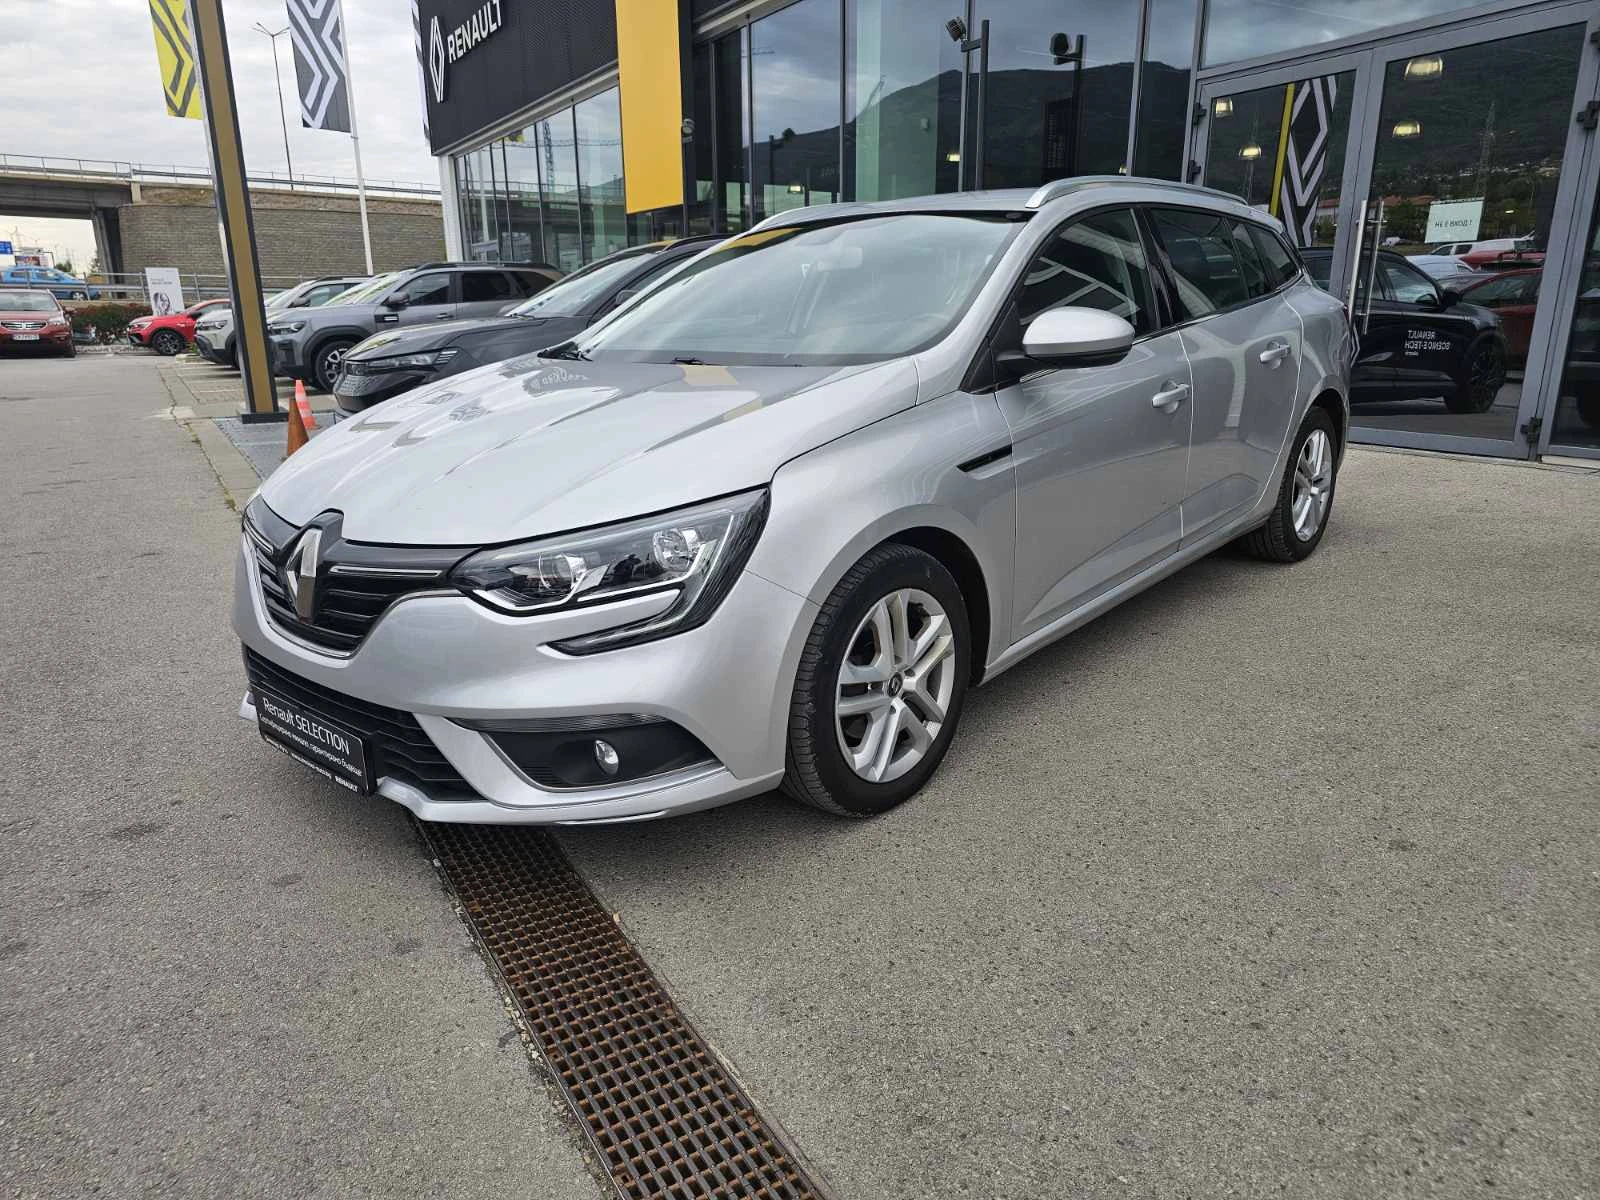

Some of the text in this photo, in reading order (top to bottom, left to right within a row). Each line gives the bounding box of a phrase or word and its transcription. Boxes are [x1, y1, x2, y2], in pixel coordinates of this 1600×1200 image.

[447, 0, 501, 63] RENAULT
[262, 696, 296, 727] Renault
[295, 714, 350, 756] SELECTION
